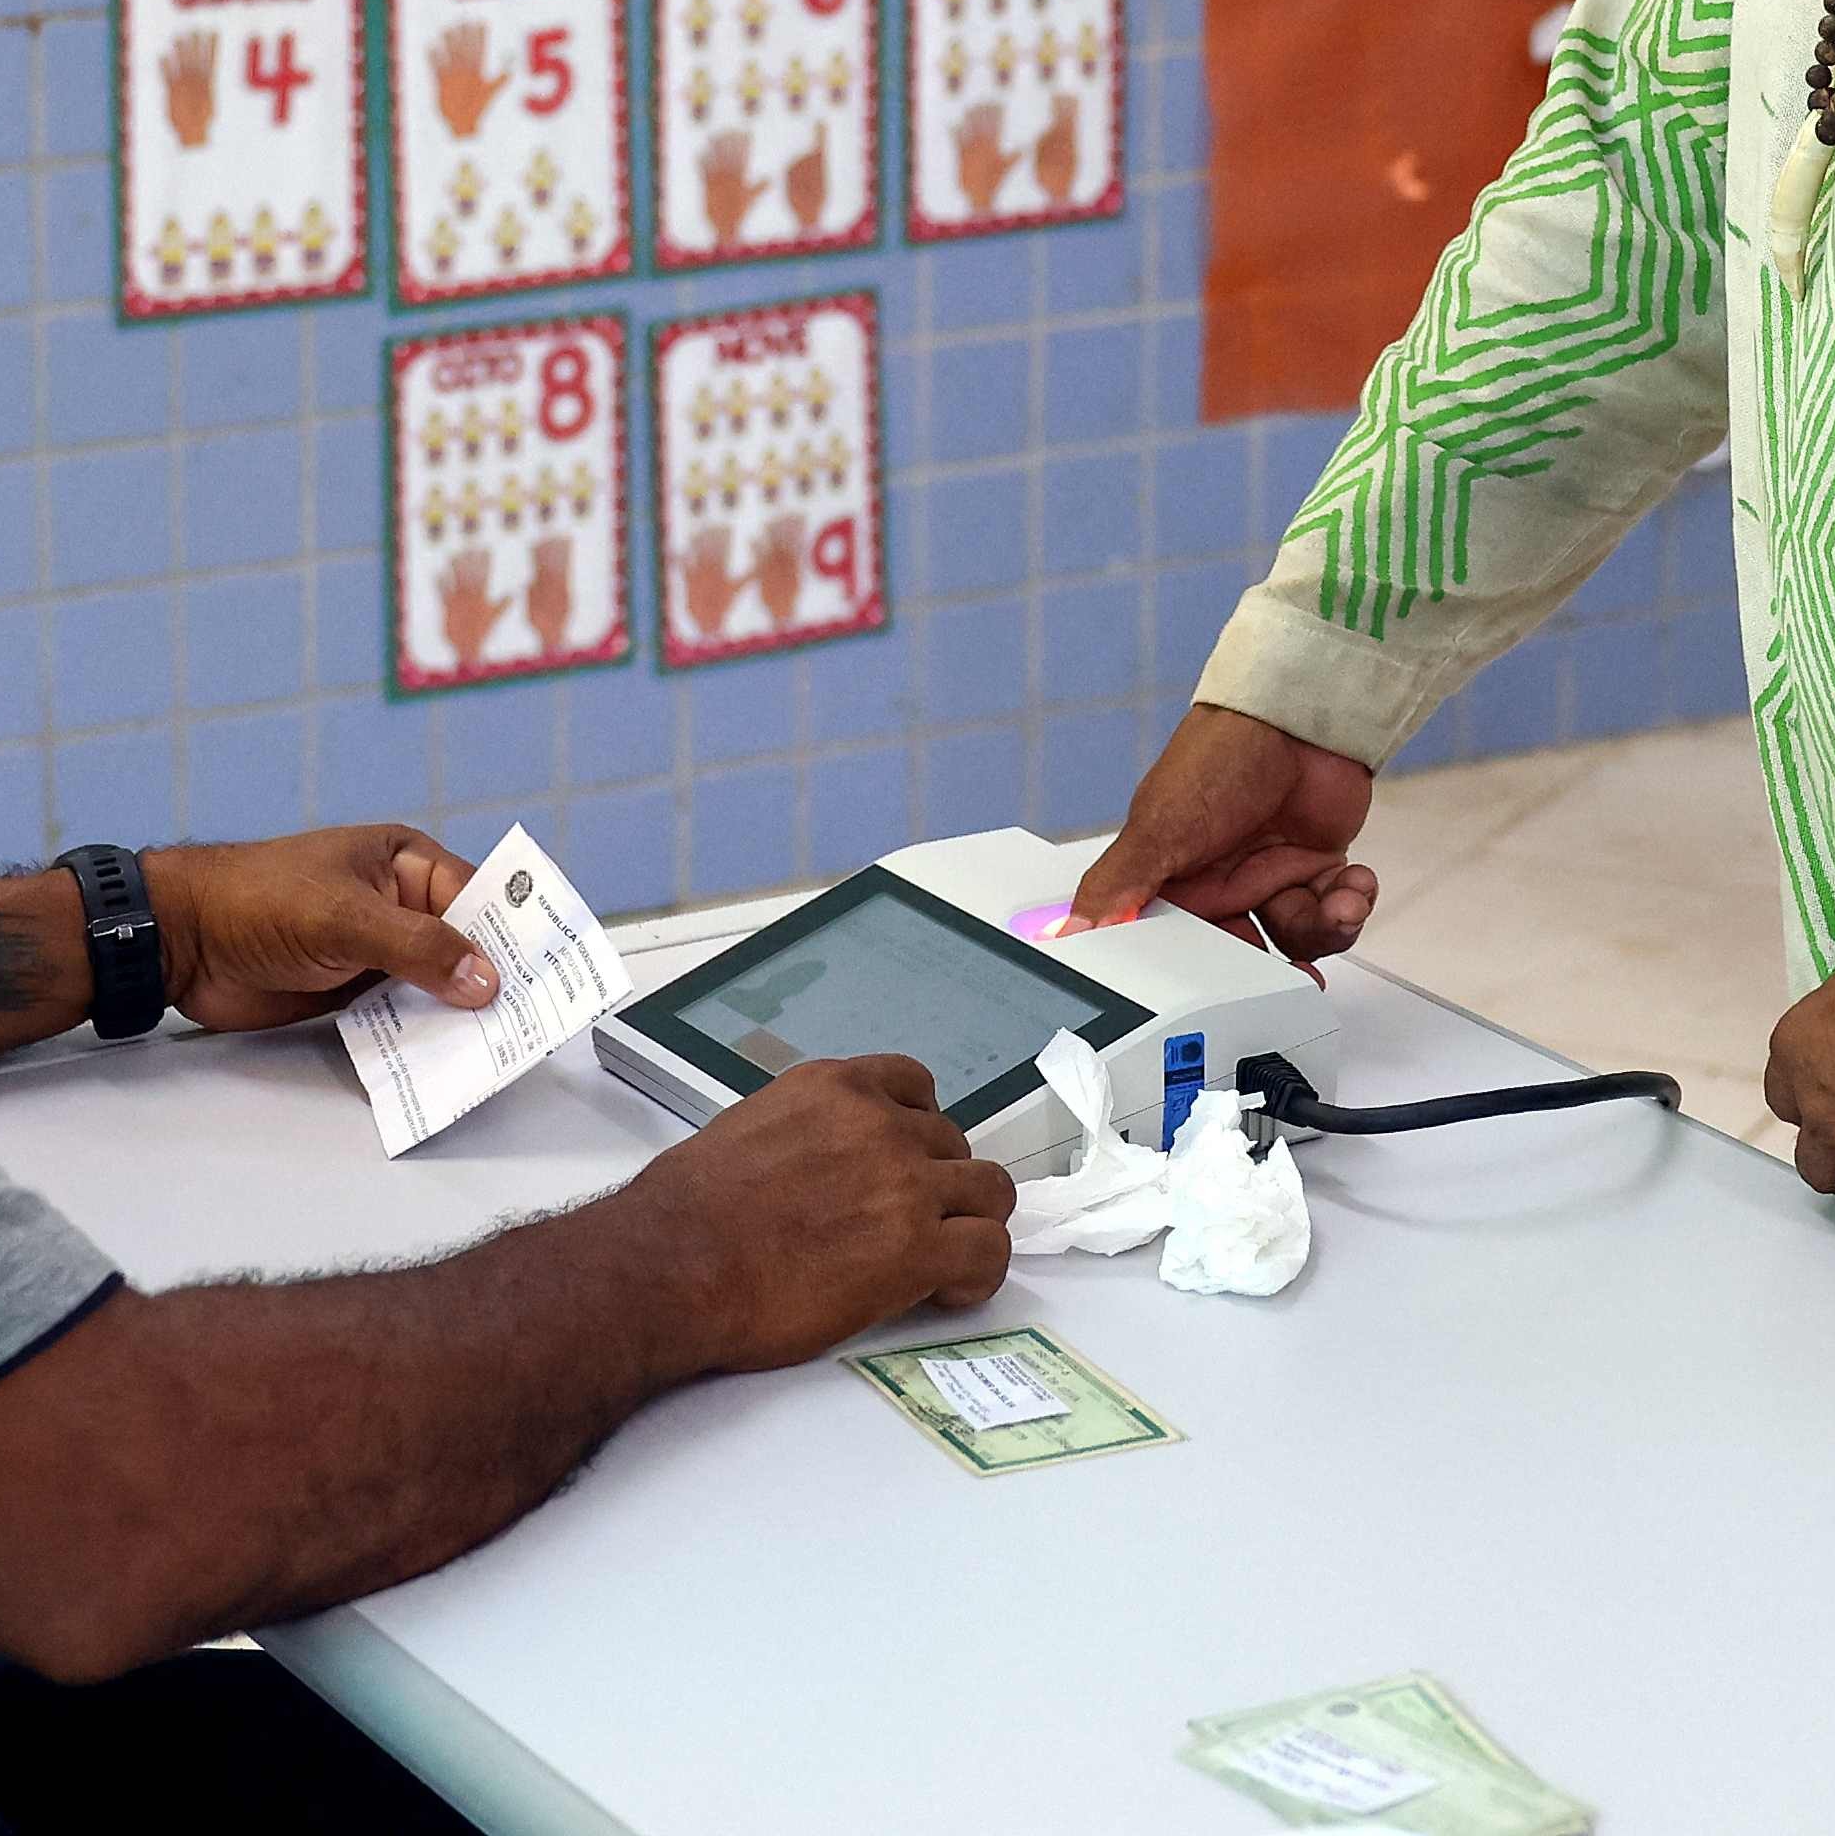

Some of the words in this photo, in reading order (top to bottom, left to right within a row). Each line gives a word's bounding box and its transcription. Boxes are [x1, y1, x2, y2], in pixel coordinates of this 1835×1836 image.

[244, 30, 312, 126] 4
[523, 28, 576, 116] 5
[540, 346, 593, 441] 8
[810, 516, 858, 601] 9
[514, 960, 534, 985] SILVA
